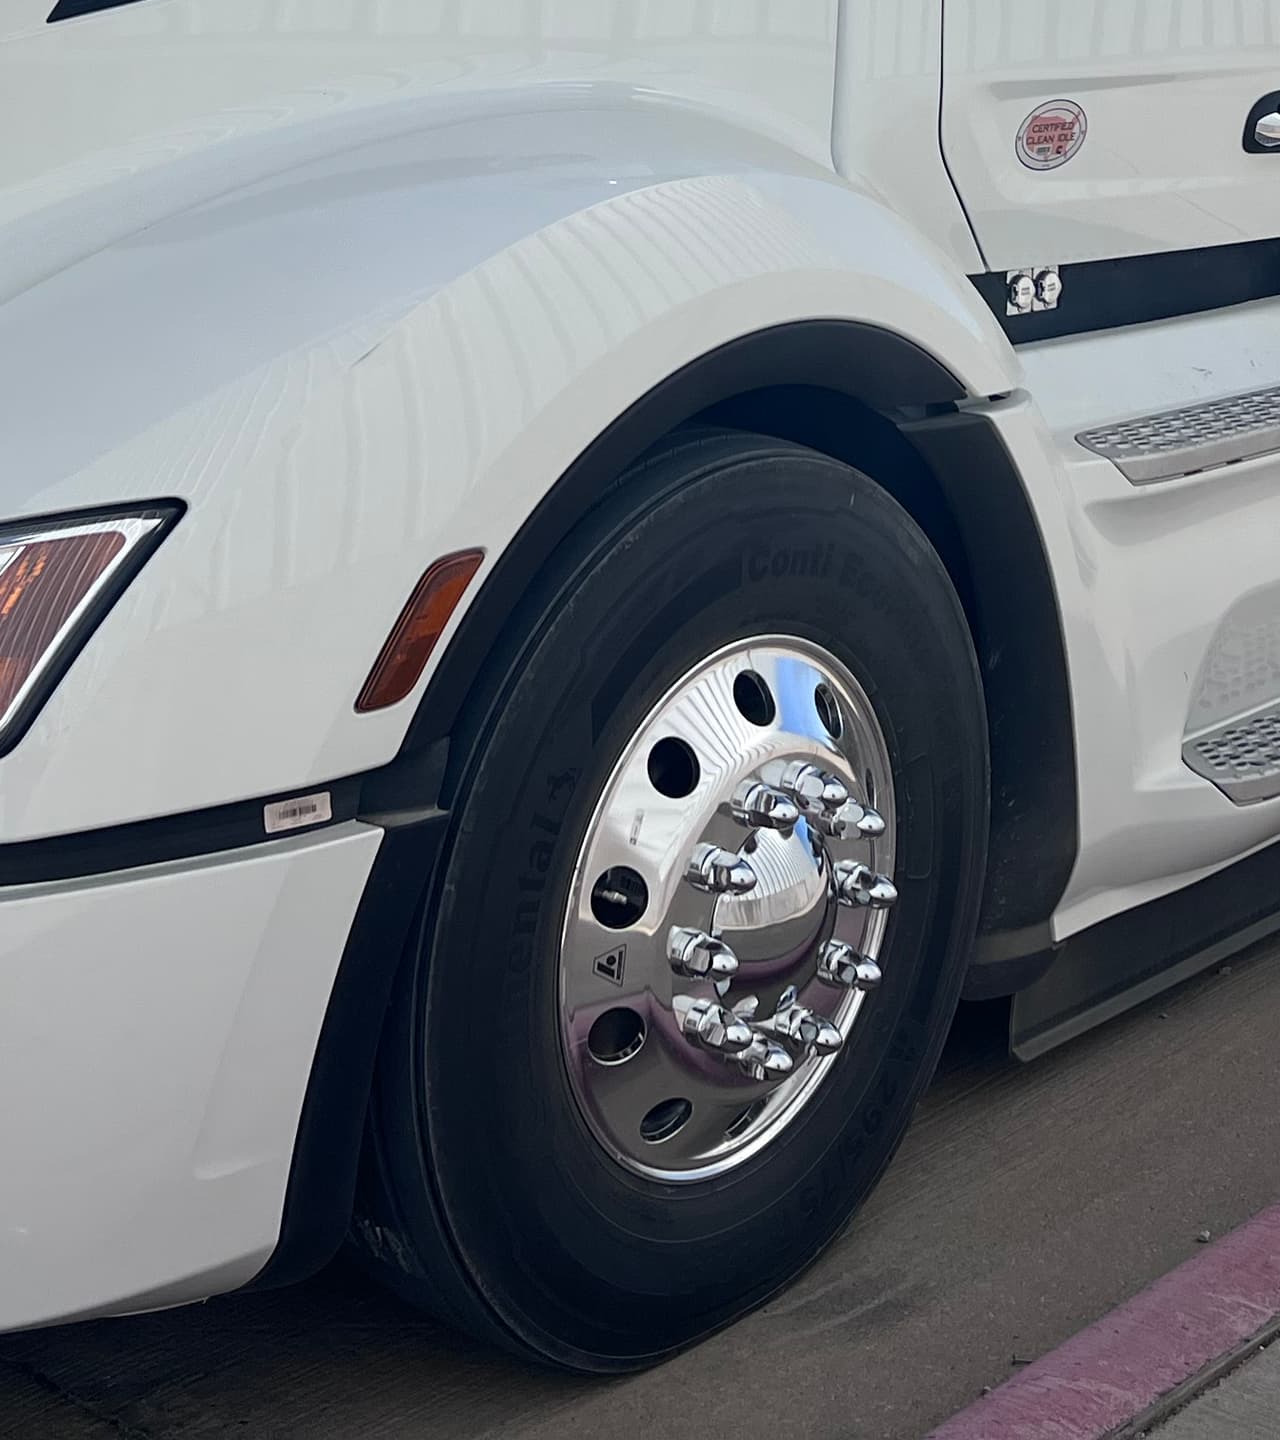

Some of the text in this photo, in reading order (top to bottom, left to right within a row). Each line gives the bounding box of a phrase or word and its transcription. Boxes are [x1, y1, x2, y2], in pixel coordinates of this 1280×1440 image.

[1032, 121, 1075, 133] CERTIFIED
[1026, 132, 1076, 146] CLEAN IDLE
